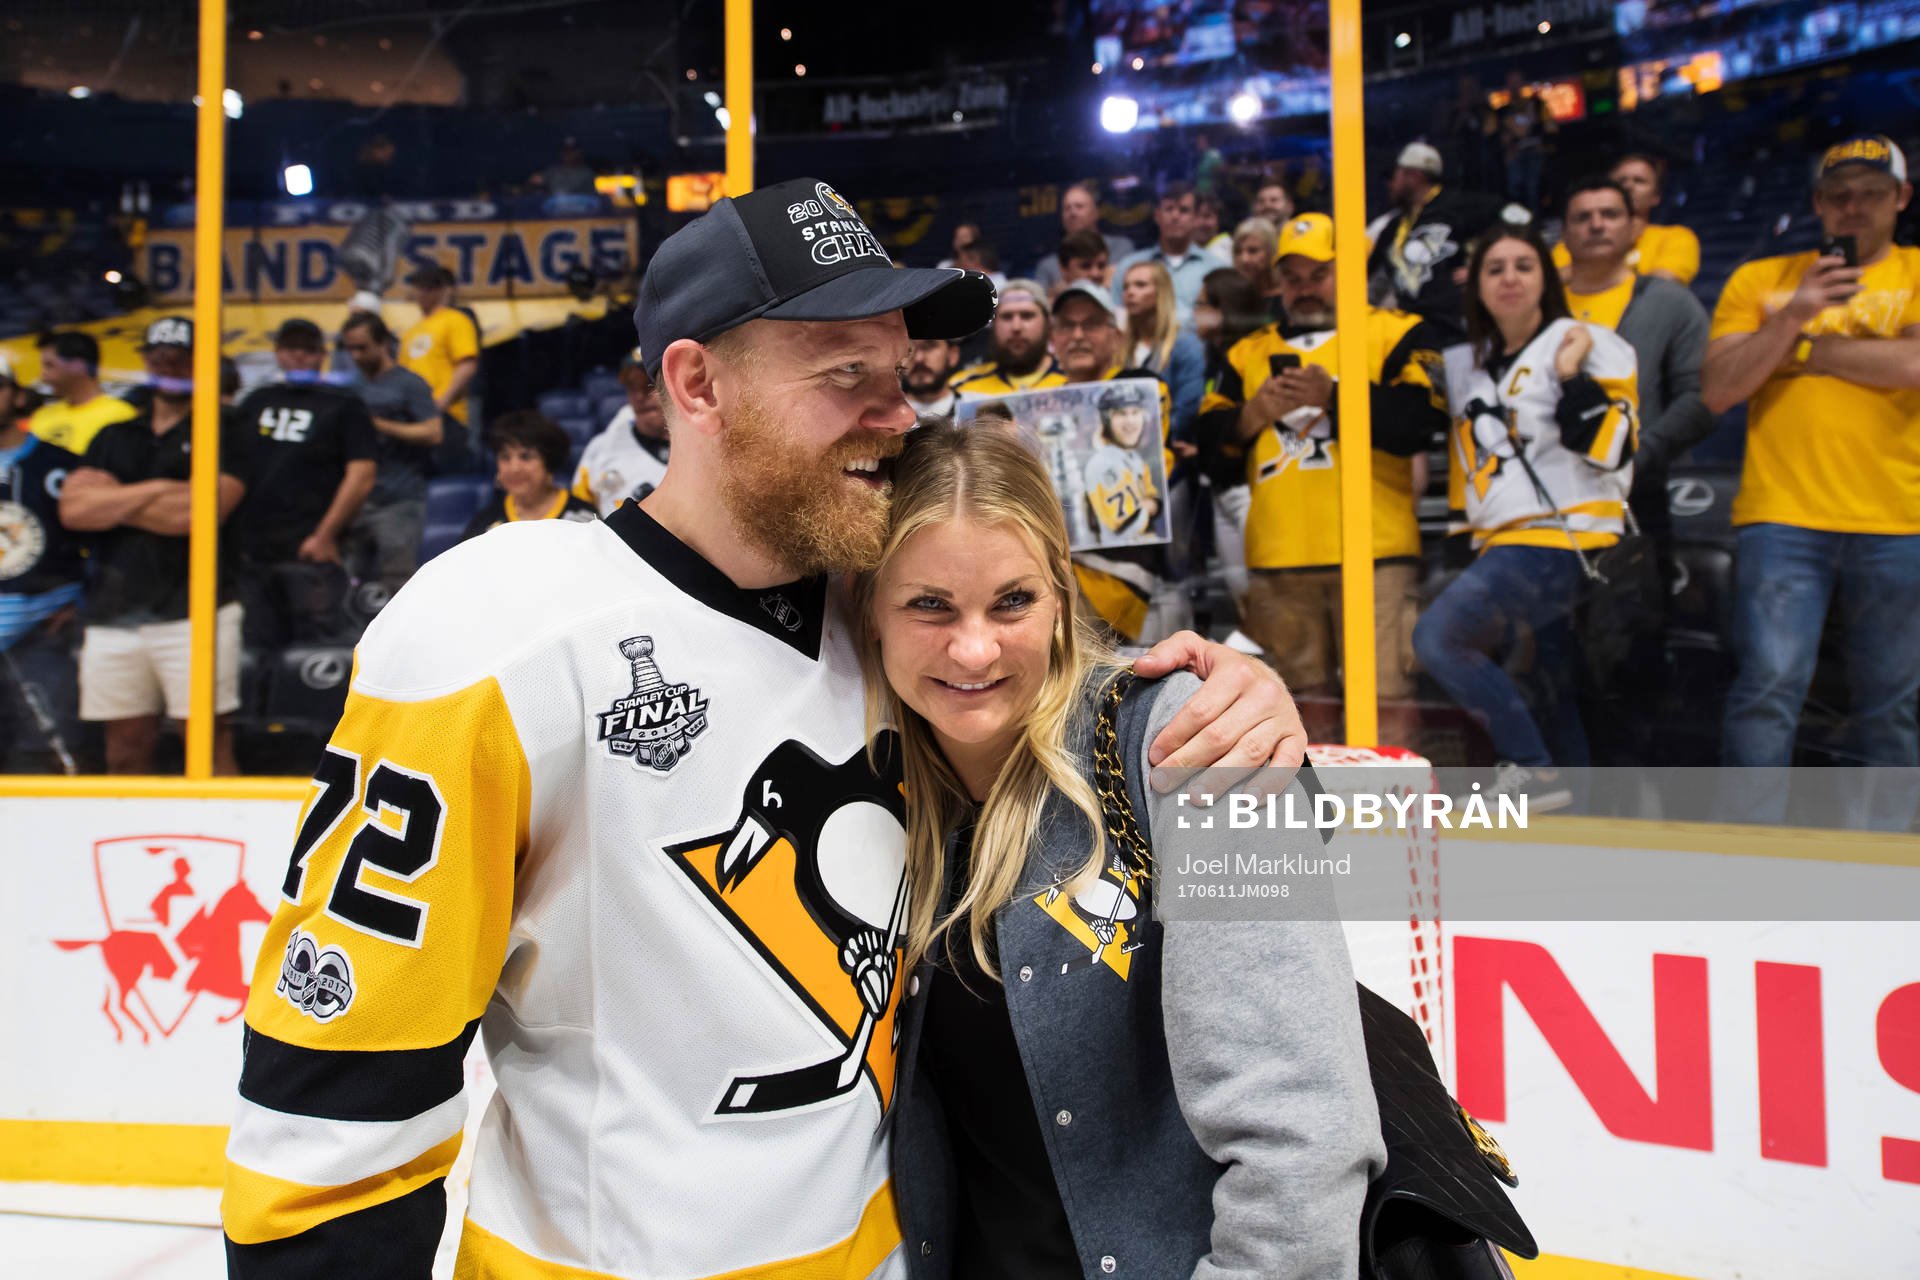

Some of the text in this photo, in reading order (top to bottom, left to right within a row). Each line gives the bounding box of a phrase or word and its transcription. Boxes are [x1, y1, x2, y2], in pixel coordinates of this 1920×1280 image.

[786, 199, 824, 224] 20
[403, 228, 627, 284] STAGE
[811, 232, 890, 265] CHA
[148, 318, 191, 345] USA
[1507, 366, 1531, 396] C
[604, 691, 706, 736] FINAL
[614, 685, 688, 712] STANLEY CUP
[638, 721, 679, 738] 2017
[282, 744, 448, 950] 72
[321, 977, 346, 995] 2017
[1453, 935, 1920, 1186] NI
